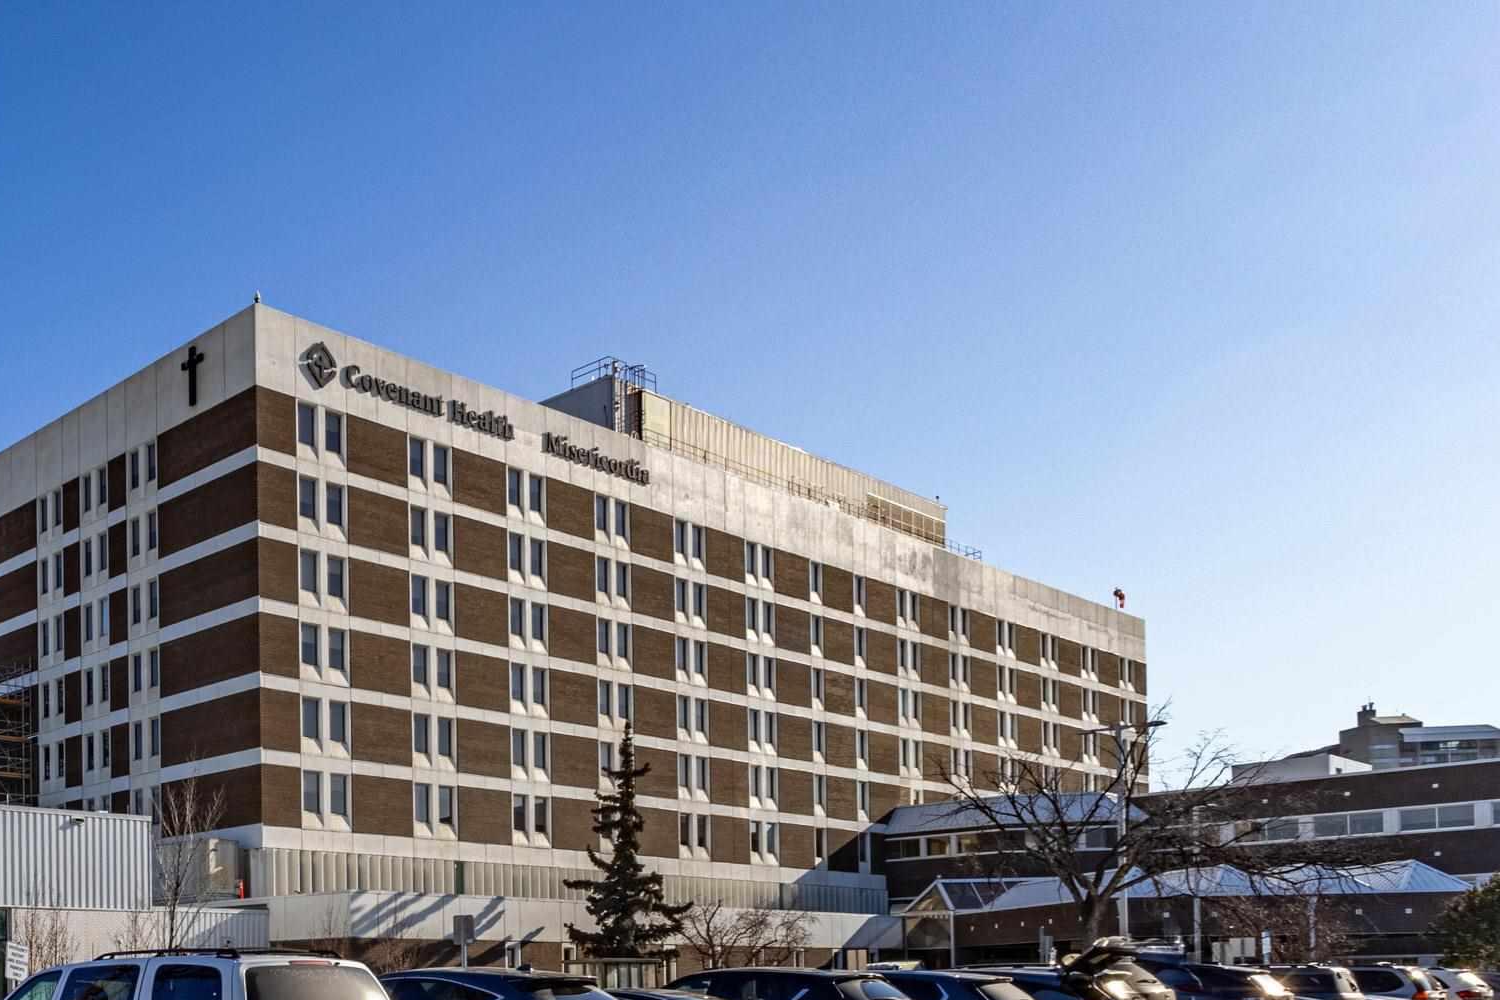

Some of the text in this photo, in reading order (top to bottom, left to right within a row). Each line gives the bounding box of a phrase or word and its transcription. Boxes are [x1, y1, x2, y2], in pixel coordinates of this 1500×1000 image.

[341, 365, 651, 486] Covenant Health Misericordia
